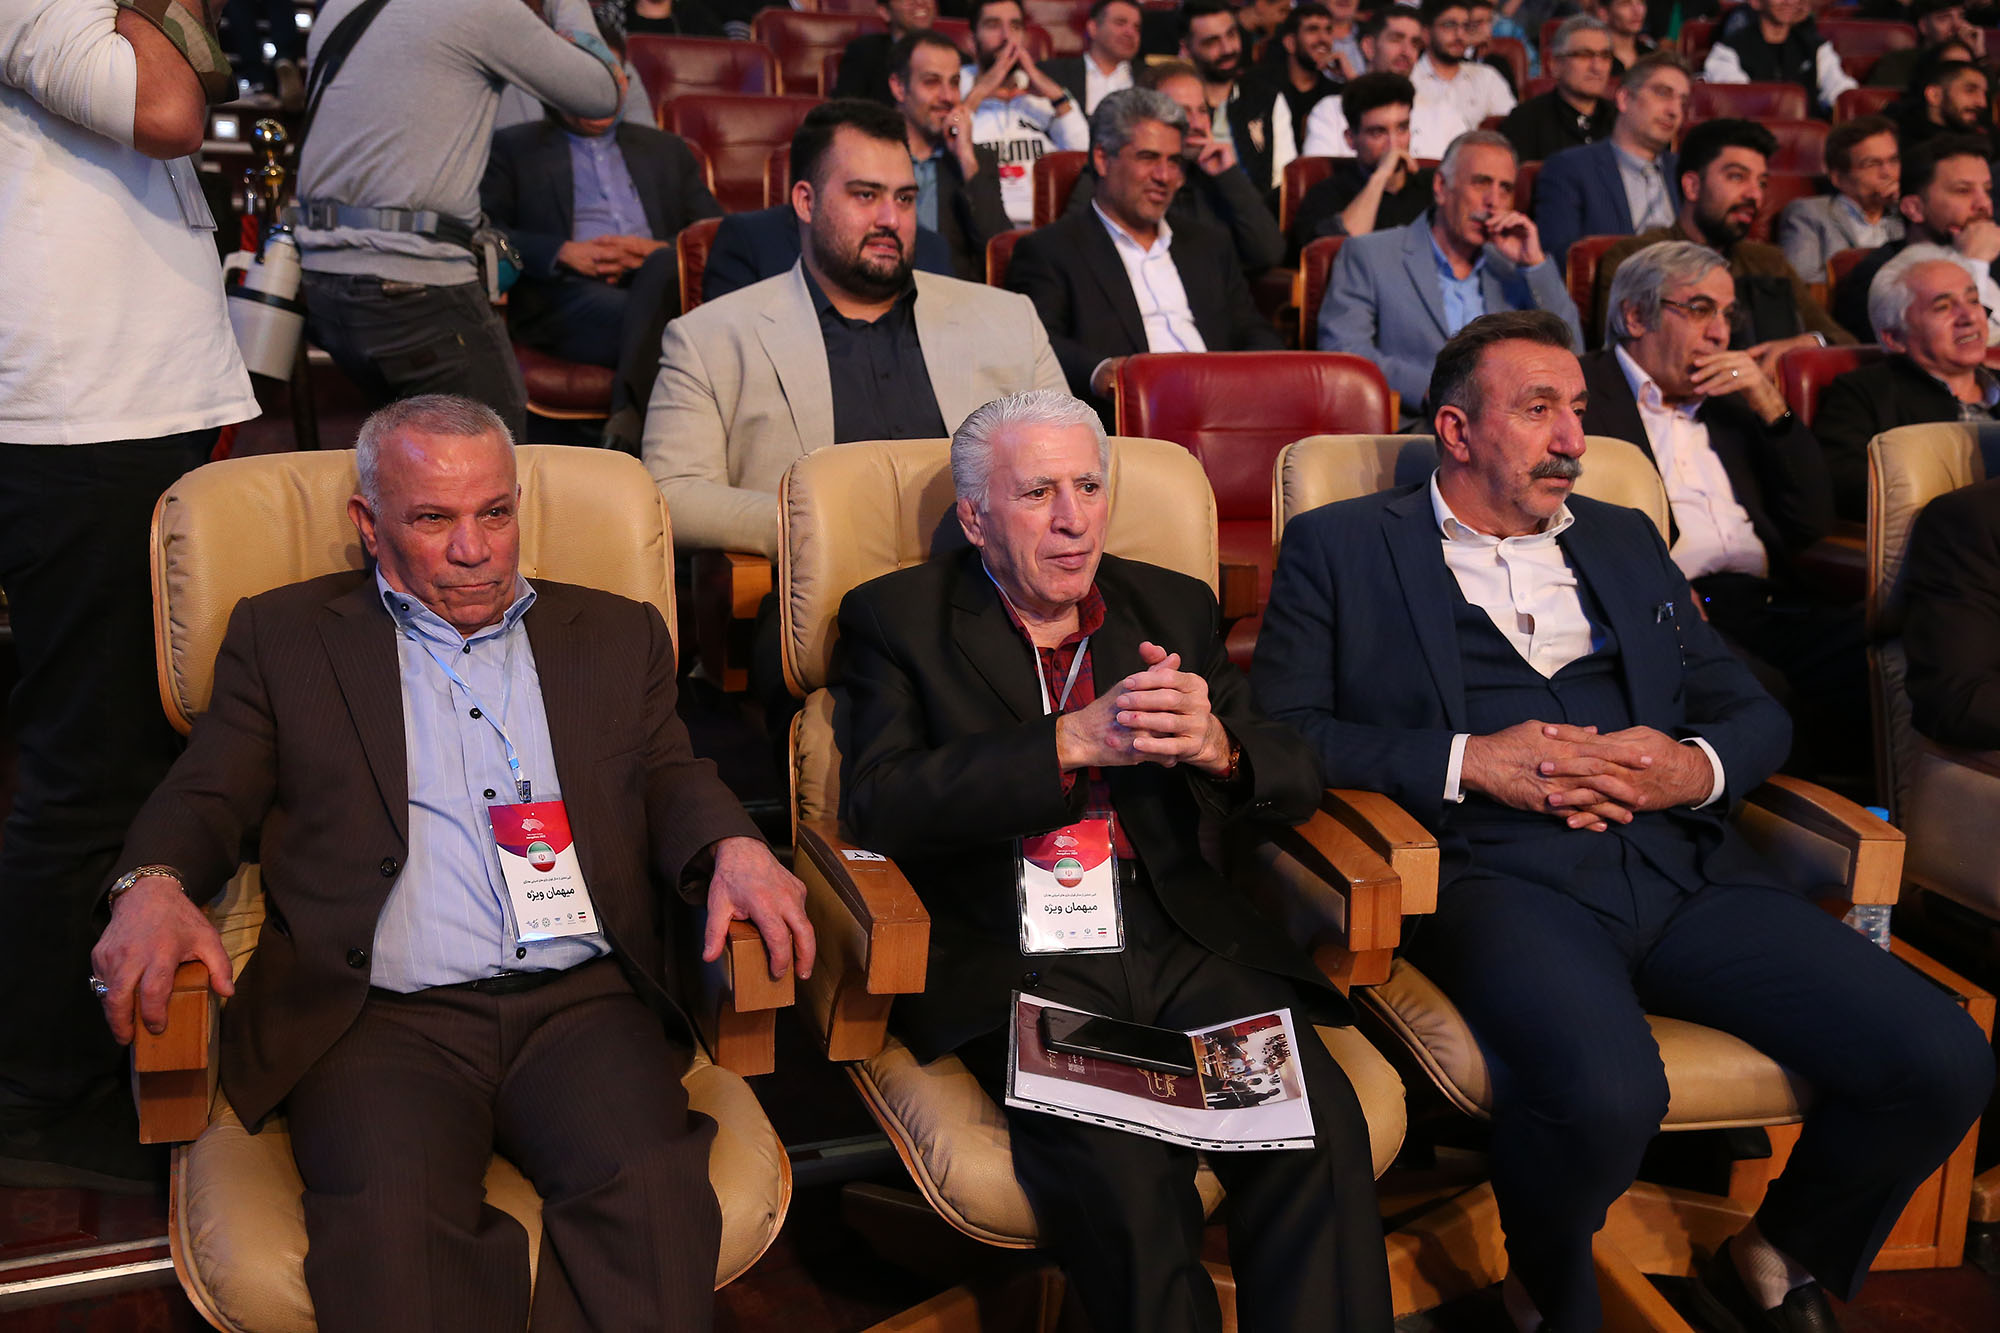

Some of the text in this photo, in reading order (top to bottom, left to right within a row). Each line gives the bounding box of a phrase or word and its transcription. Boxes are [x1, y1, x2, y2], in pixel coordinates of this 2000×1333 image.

[526, 886, 575, 902] میهمان ویژه
[1043, 901, 1098, 915] میهمان ویژه
